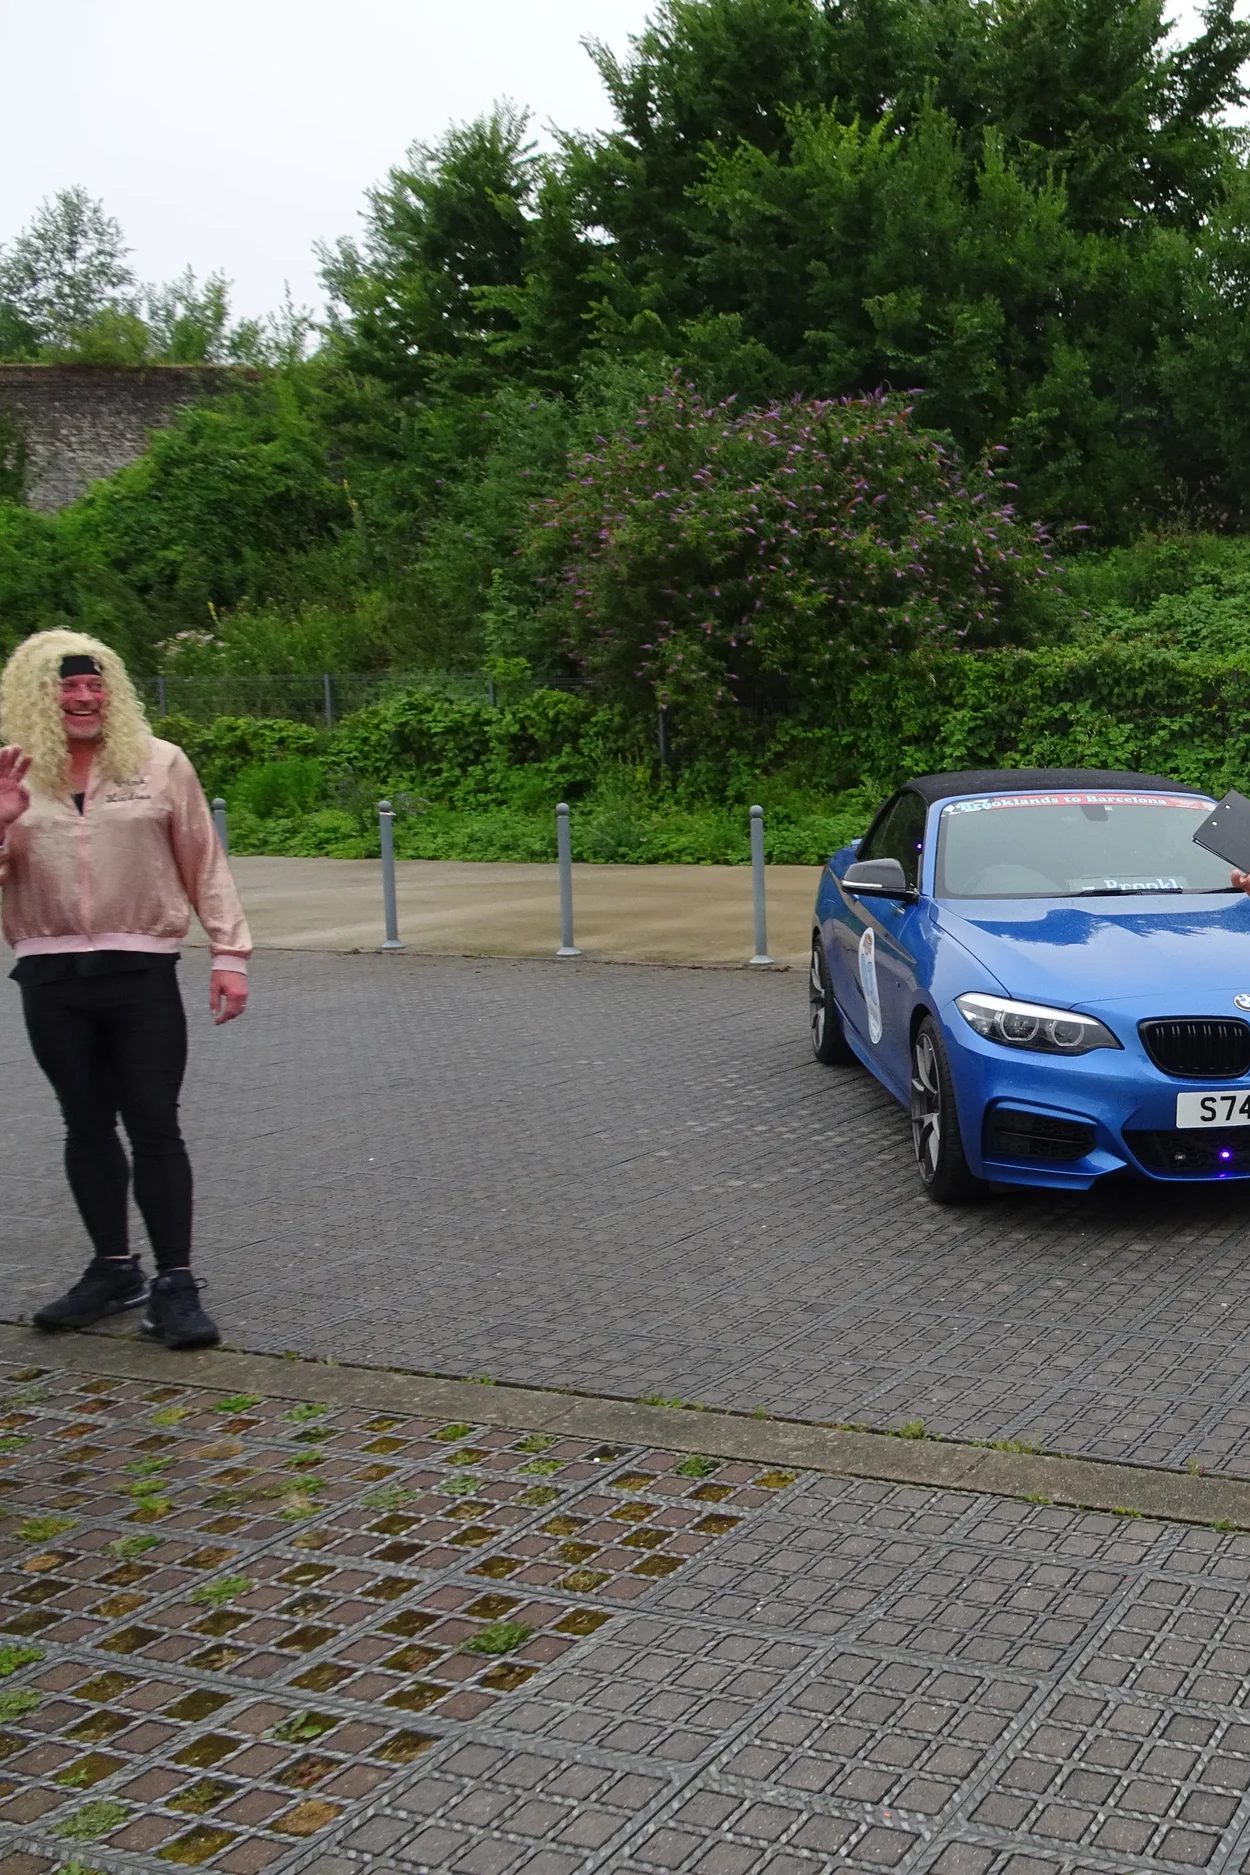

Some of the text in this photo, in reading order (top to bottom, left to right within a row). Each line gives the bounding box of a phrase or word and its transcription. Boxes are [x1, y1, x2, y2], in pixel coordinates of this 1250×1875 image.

[960, 796, 1059, 811] Brooklands
[1063, 796, 1081, 804] to
[1085, 795, 1167, 805] Barcelona
